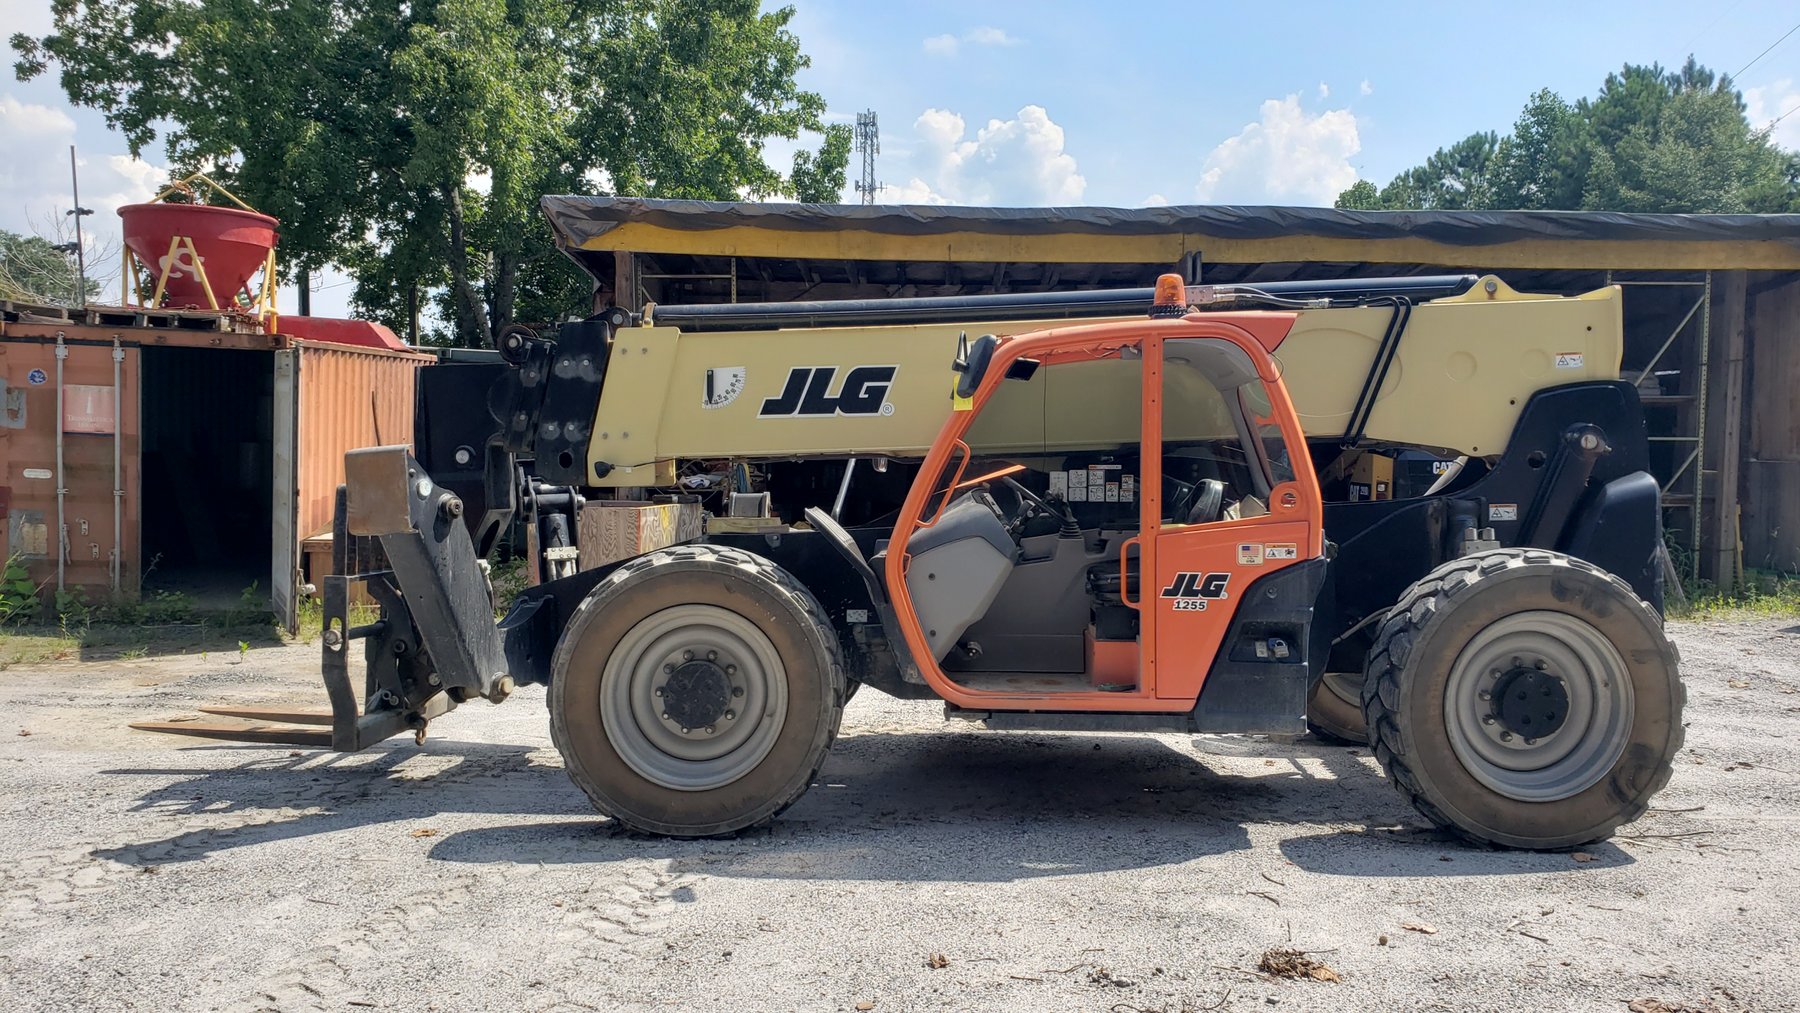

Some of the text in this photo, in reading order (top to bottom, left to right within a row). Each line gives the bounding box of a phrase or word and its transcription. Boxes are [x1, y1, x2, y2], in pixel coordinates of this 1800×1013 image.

[759, 366, 897, 415] JLG
[1161, 573, 1230, 597] JLG
[1174, 600, 1206, 610] 1255
